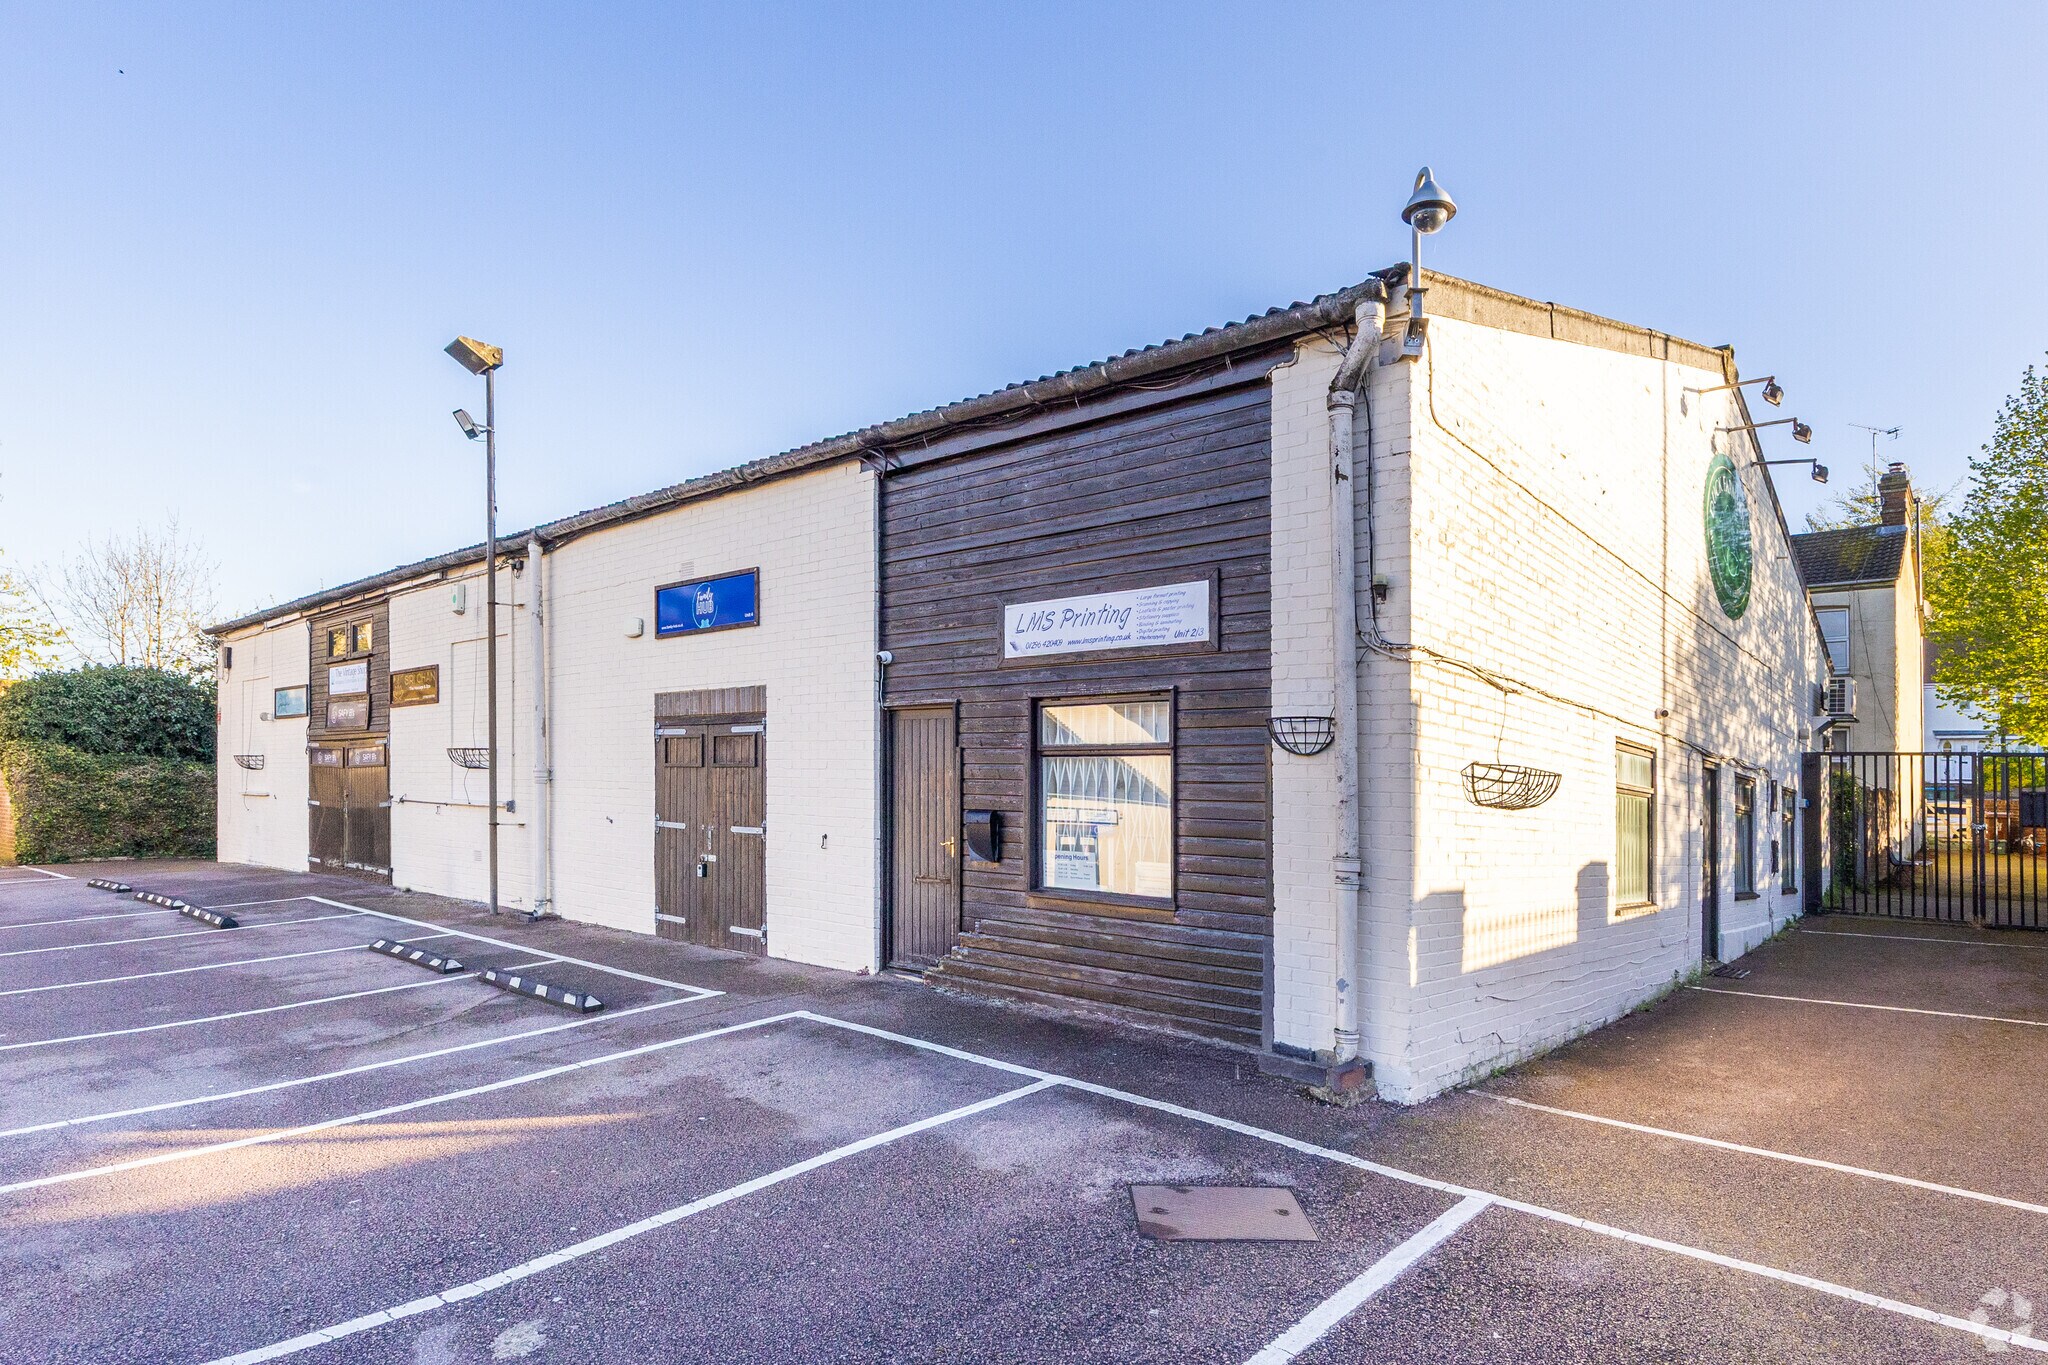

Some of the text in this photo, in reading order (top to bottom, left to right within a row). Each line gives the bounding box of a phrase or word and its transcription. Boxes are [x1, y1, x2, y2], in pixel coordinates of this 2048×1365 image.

[696, 598, 714, 615] HUB
[1015, 603, 1132, 634] LMS Printing
[1067, 634, 1132, 646] www.lmsprinting.co.uk
[1174, 627, 1205, 639] Unit 2/3
